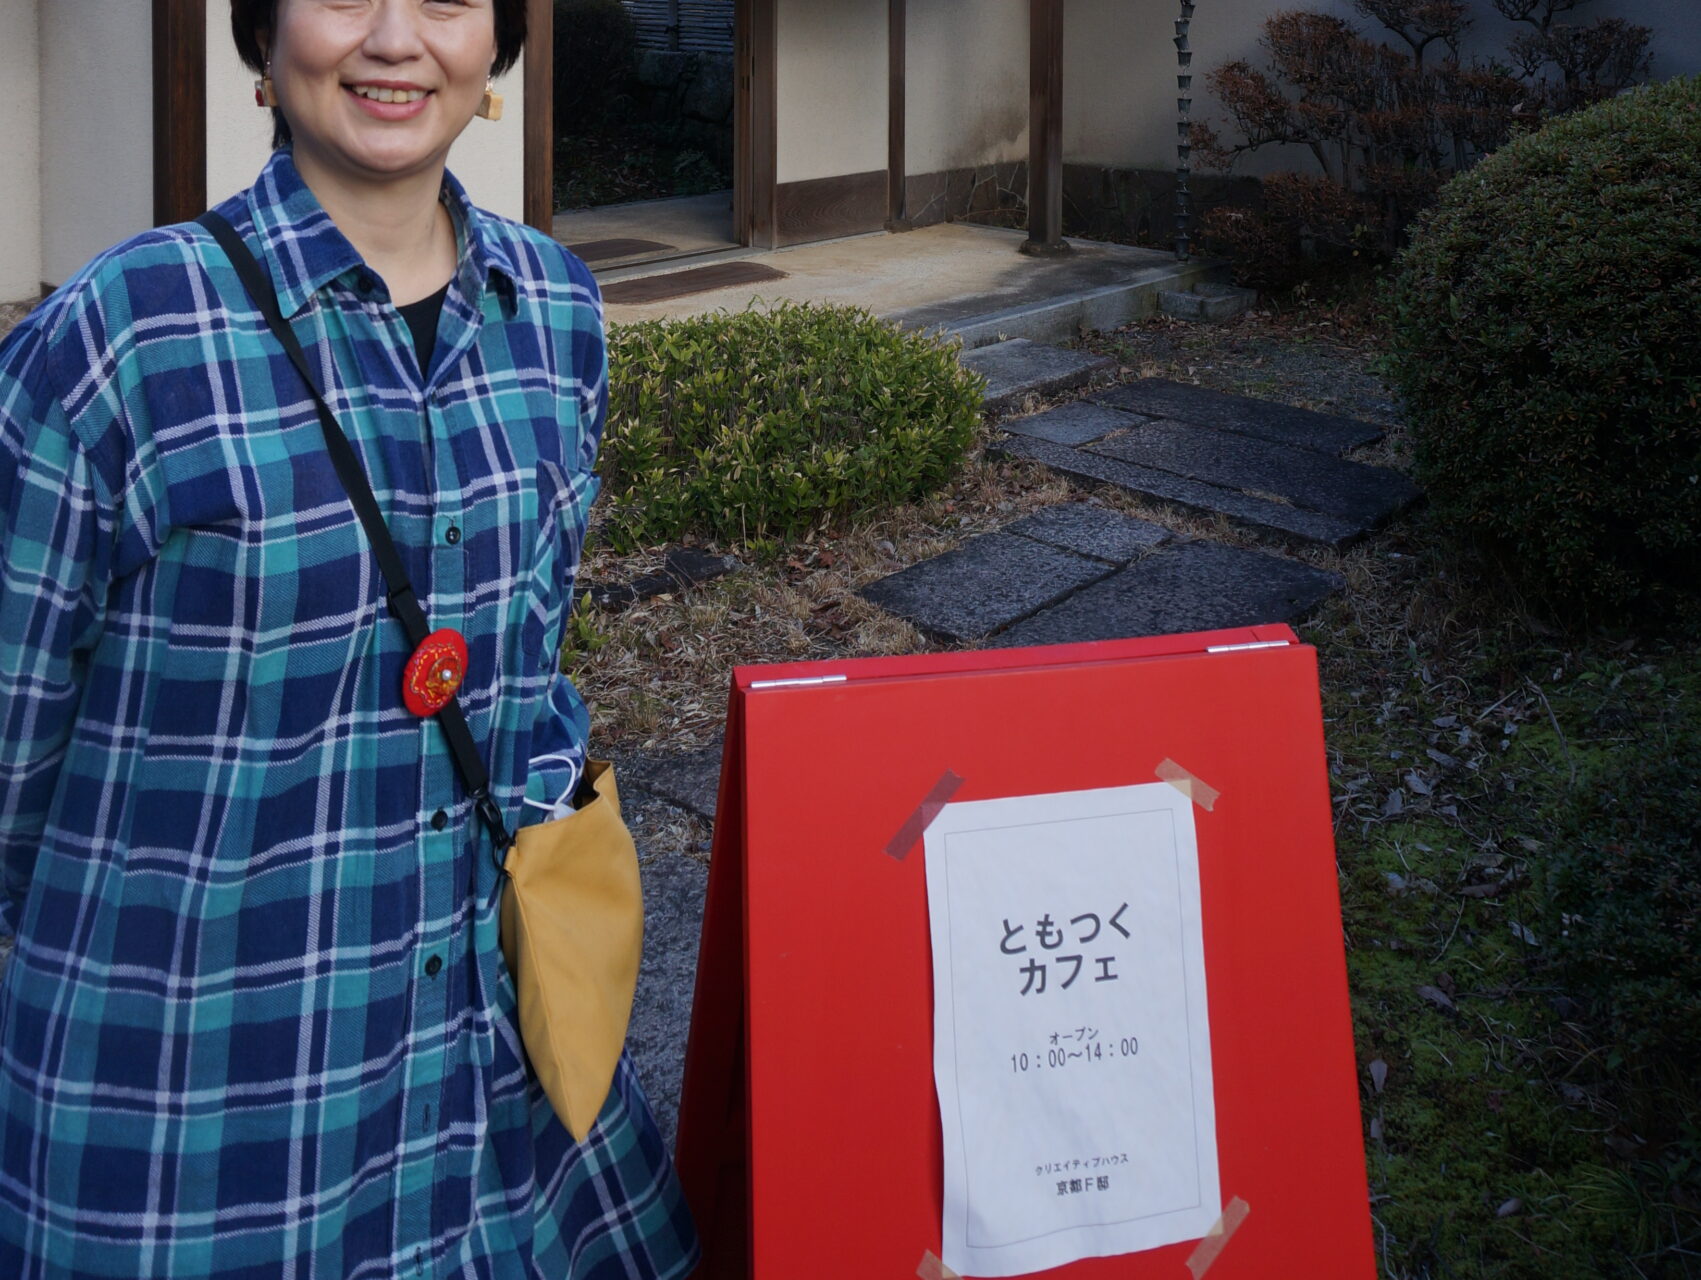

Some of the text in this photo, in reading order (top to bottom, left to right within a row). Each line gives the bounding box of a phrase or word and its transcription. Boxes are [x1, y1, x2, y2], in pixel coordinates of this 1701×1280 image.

[1000, 902, 1131, 955] ともつく
[1019, 954, 1118, 996] カフェ
[1050, 1027, 1099, 1046] オープン
[1035, 1153, 1128, 1176] クリエイティブハウス
